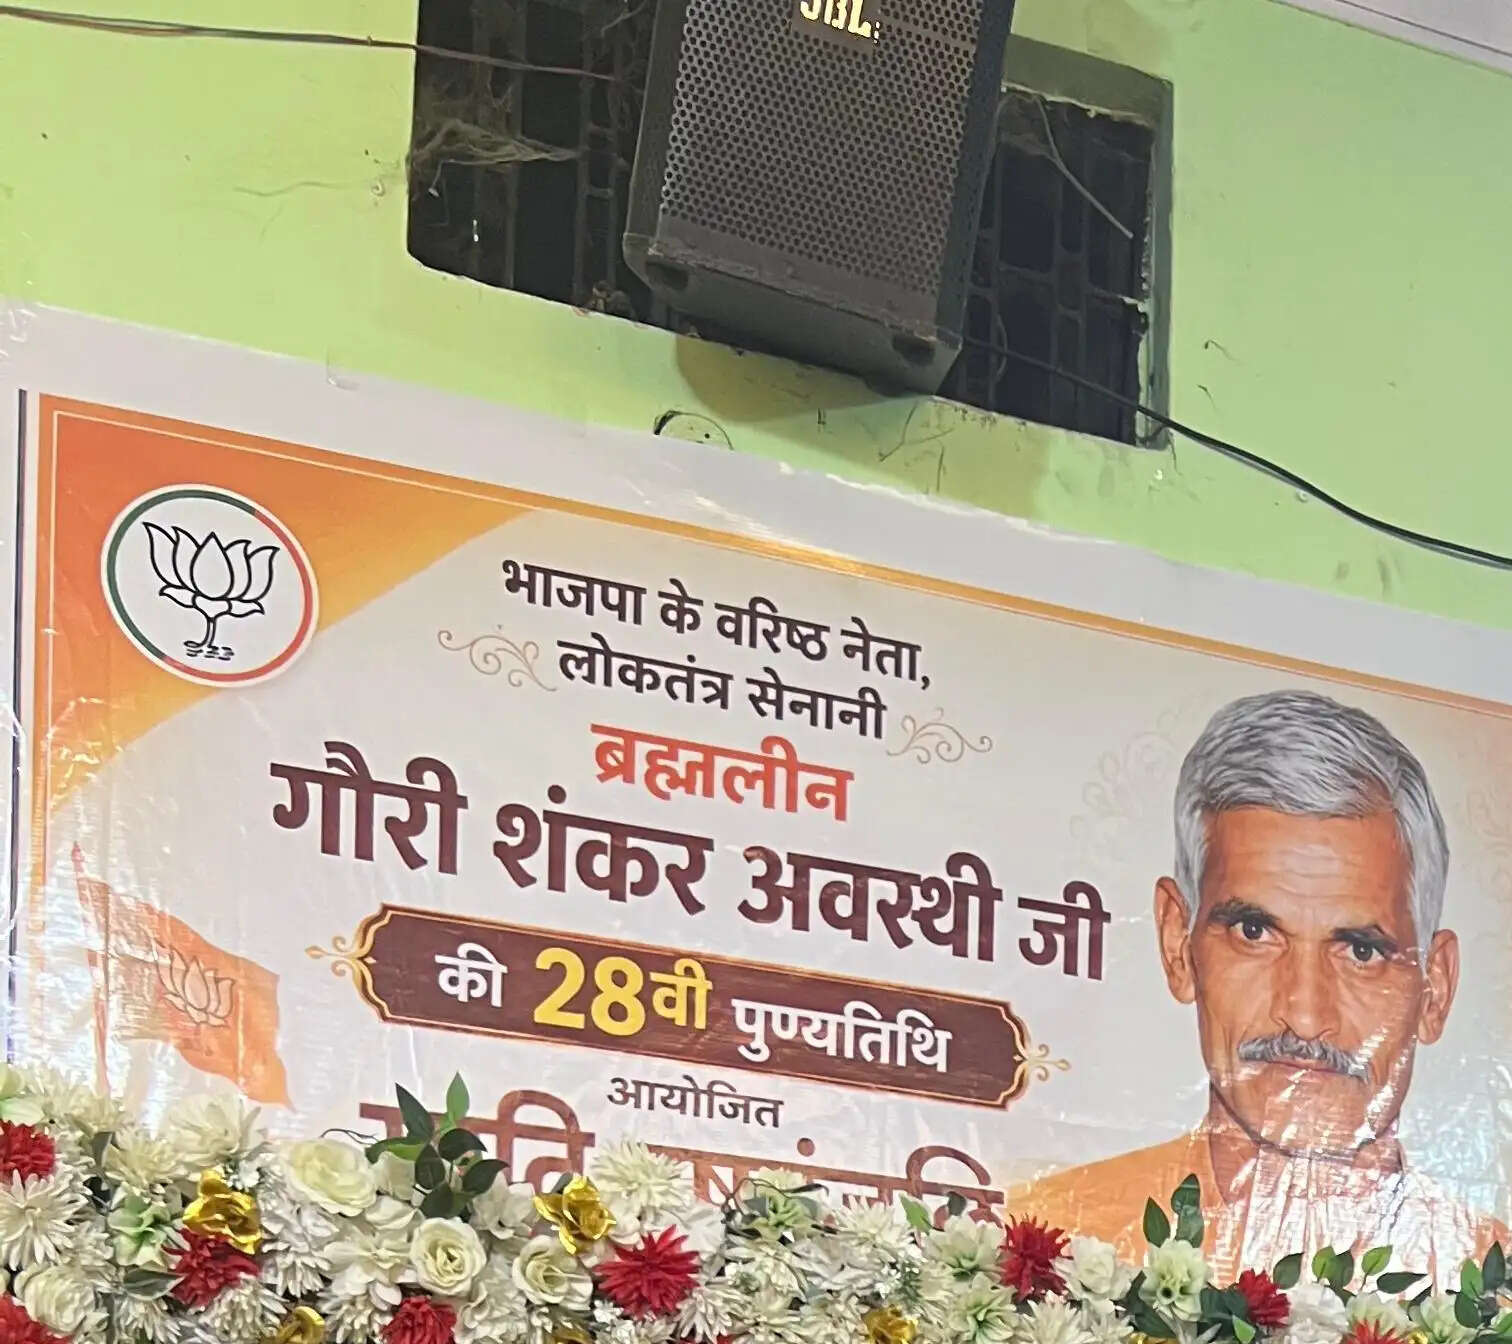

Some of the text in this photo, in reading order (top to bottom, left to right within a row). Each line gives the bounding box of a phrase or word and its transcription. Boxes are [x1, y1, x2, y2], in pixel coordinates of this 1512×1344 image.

[502, 559, 932, 690] भाजपा के वरिष्ठ नेता,
[556, 632, 887, 740] लोकतंत्र सेनानी
[590, 723, 855, 822] ब्रह्मलीन
[269, 740, 1112, 982] गौरी शंकर अवस्थी जी
[434, 942, 509, 1009] की
[730, 999, 953, 1073] पुण्यतिथि
[606, 1072, 784, 1129] आयोजित
